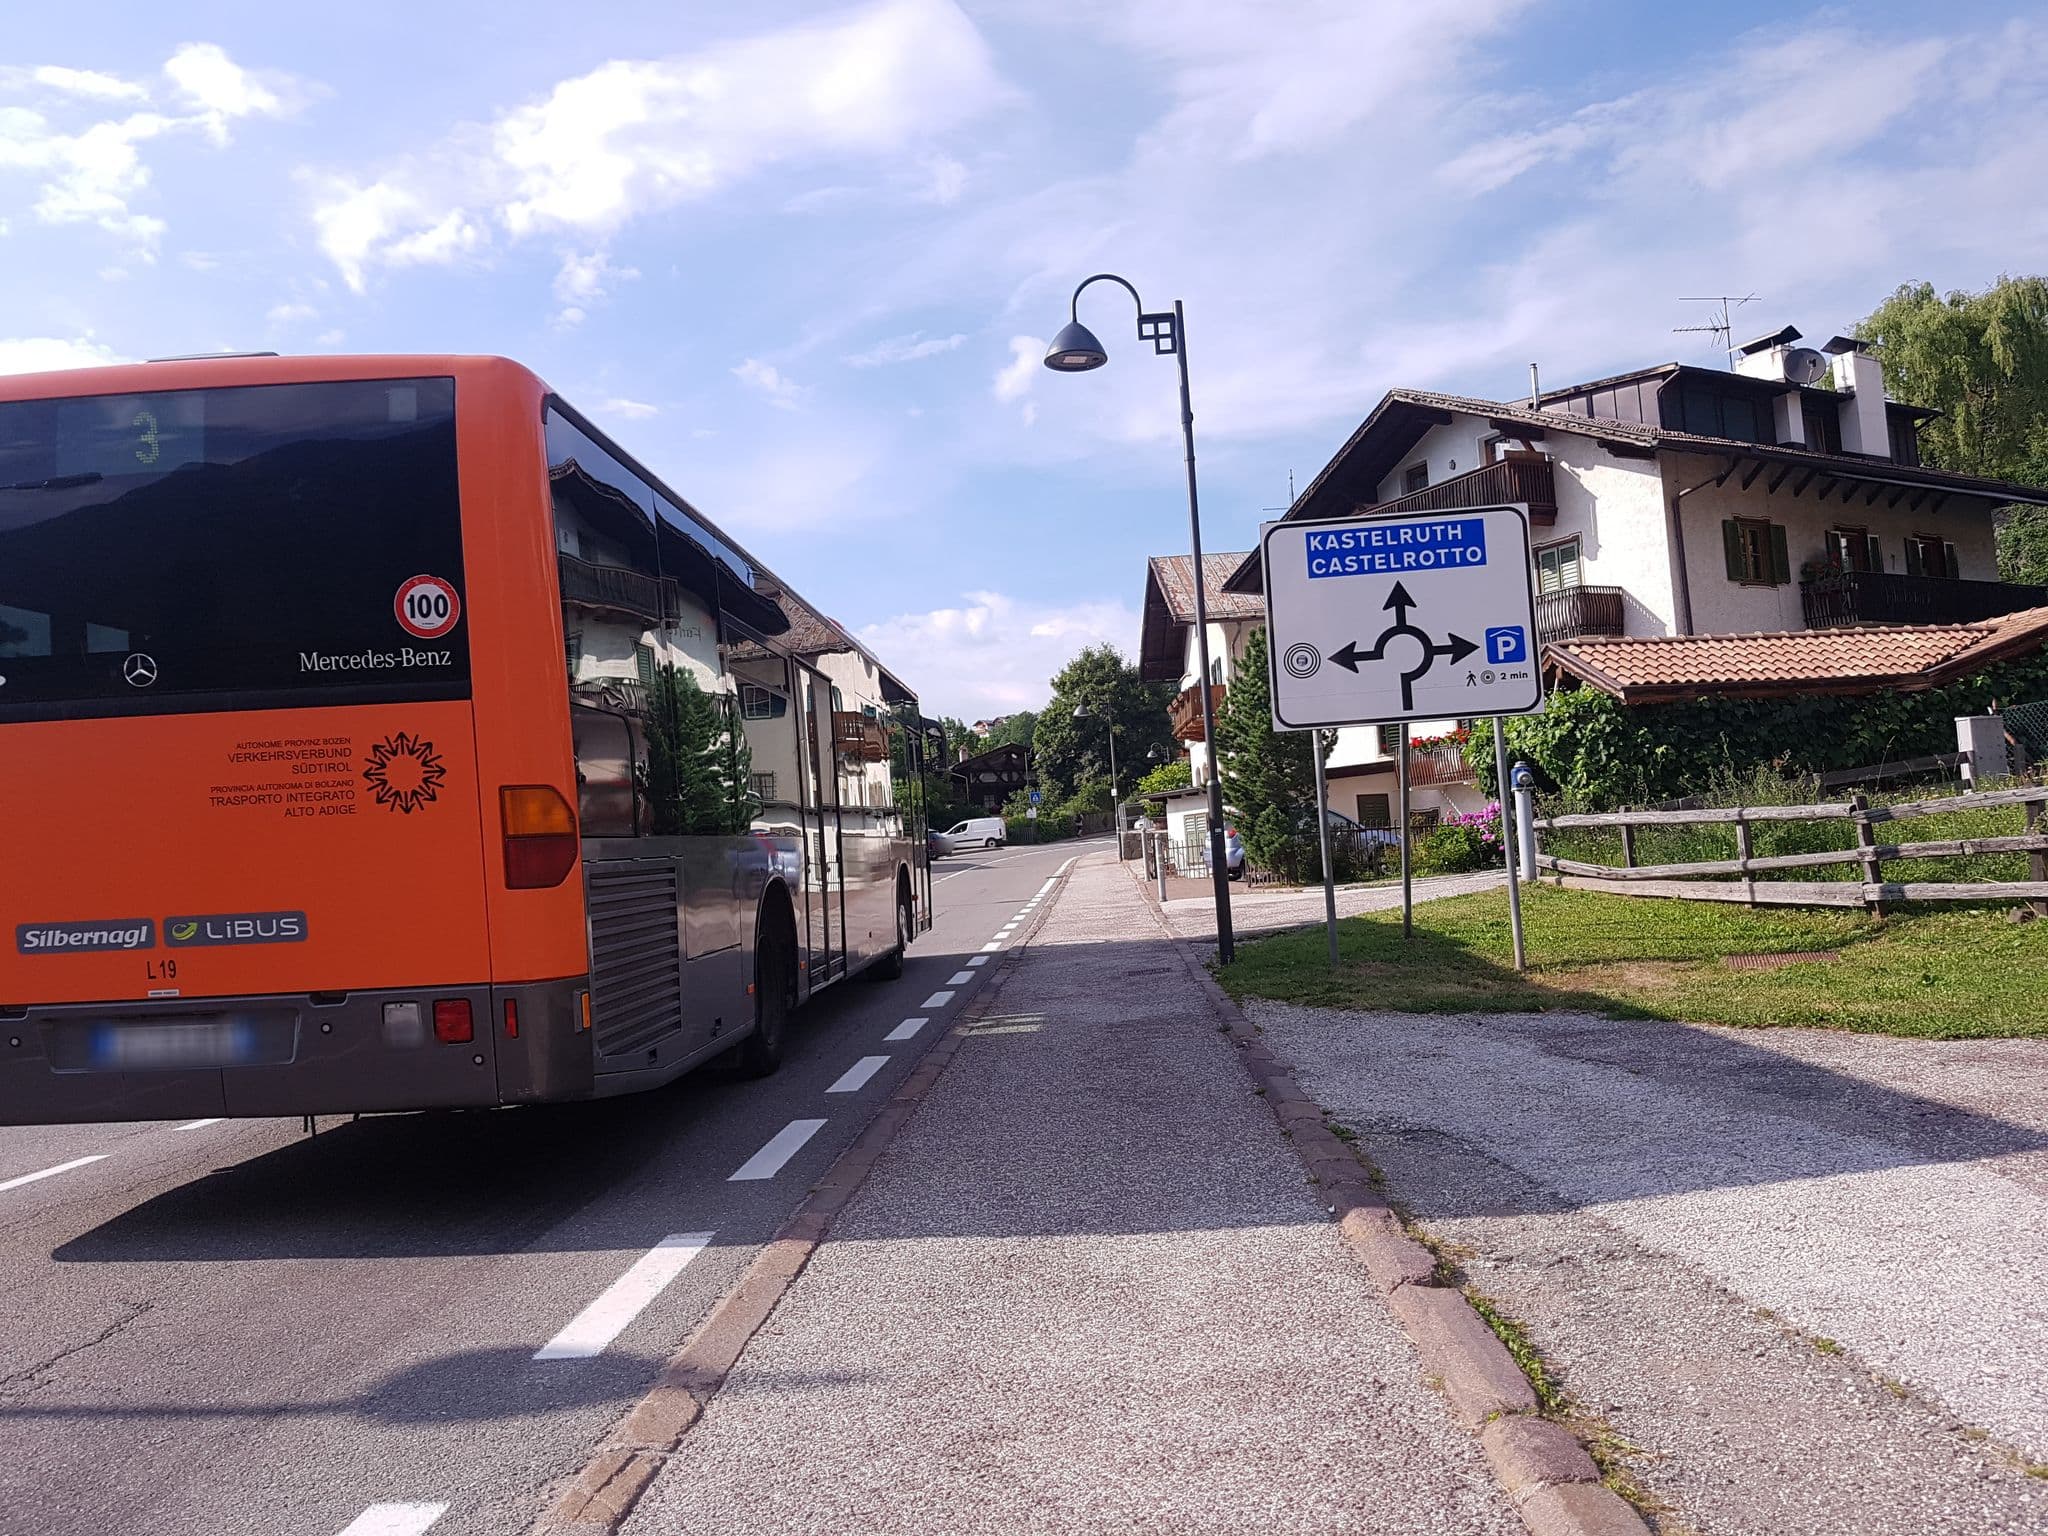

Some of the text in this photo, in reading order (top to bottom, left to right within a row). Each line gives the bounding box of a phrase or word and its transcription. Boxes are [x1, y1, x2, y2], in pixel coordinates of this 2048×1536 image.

[132, 411, 160, 465] 3
[1309, 524, 1463, 552] KASTELRUTH
[1311, 546, 1482, 574] CASTELROTTO
[407, 593, 449, 619] 100
[1496, 636, 1516, 660] P
[300, 647, 452, 672] Mercedes-Benz
[1500, 671, 1528, 680] 2 min
[236, 737, 351, 750] AUTONOME PROVINZ BOZEN
[227, 747, 352, 763] VERKEHRSVERBUND
[292, 762, 352, 774] SÜDTIROL
[210, 779, 354, 793] PROVINCIA AUTONOMA DI BOLZANO
[209, 790, 355, 807] TRASPORTO INTEGRATO
[284, 804, 357, 818] ALTO ADIGE
[23, 925, 148, 949] Silbernagl
[206, 918, 300, 939] LiBUS
